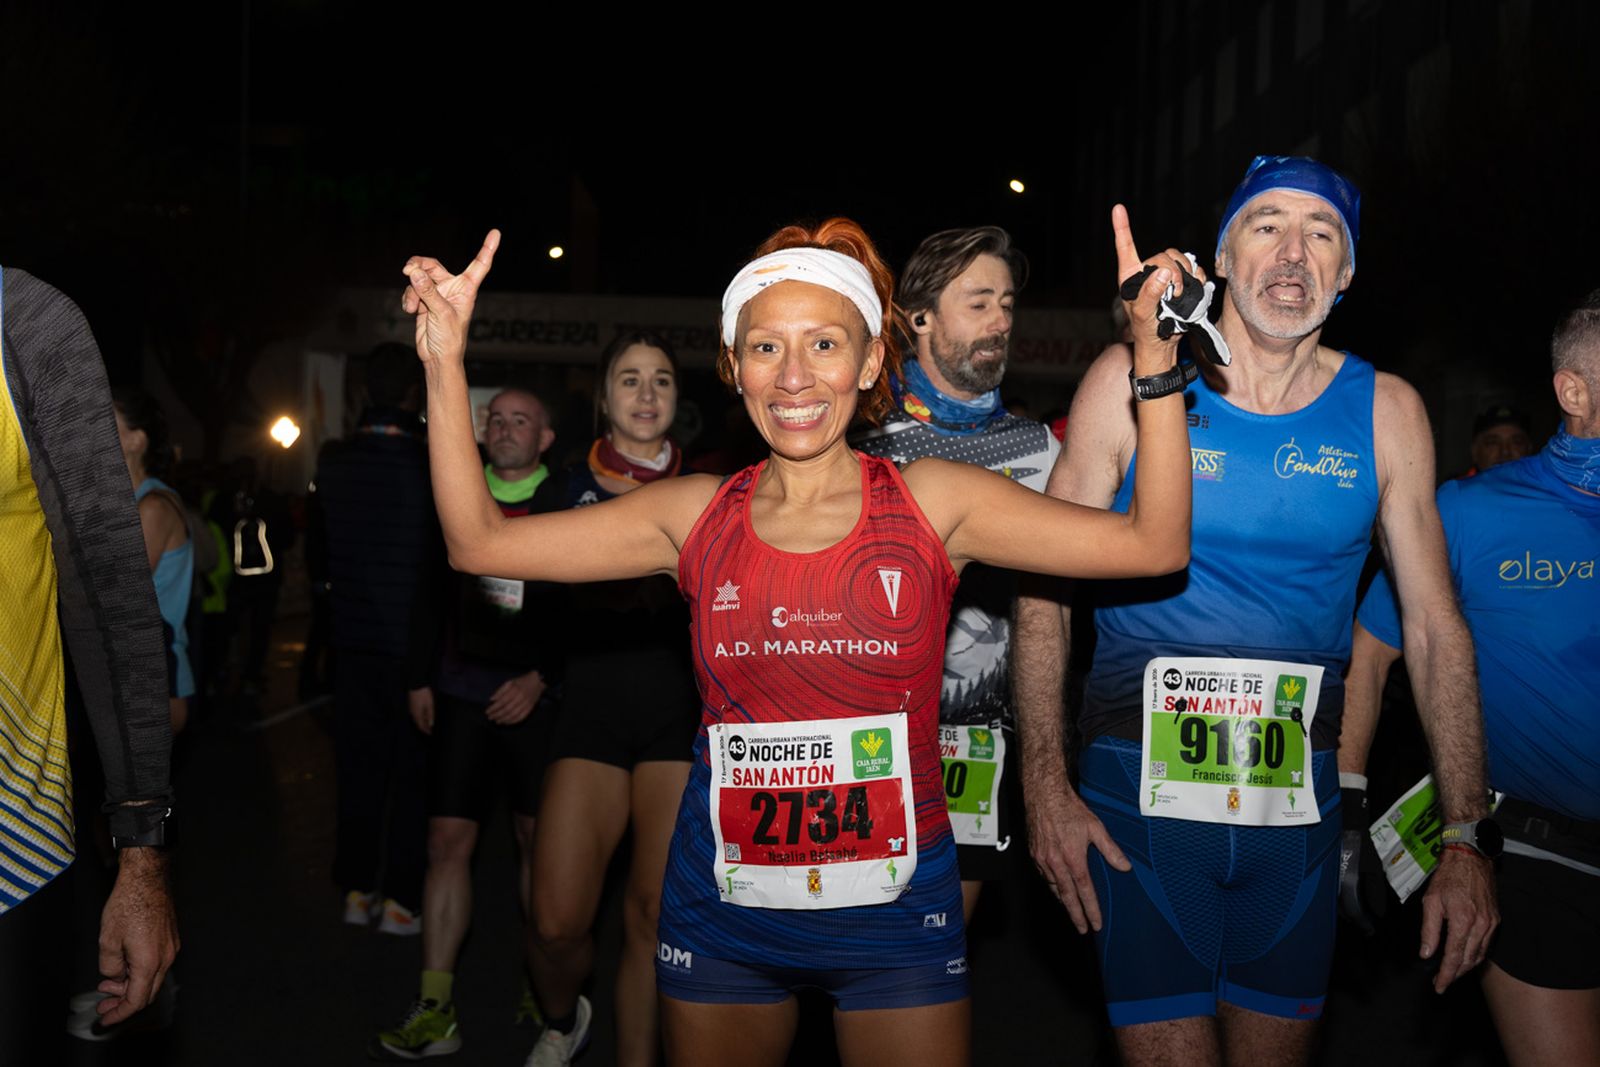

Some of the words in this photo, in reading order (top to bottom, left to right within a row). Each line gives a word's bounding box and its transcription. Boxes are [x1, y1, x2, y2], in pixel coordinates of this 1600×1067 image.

[470, 319, 598, 345] CARRERA
[1014, 338, 1072, 364] SAN
[1283, 452, 1358, 479] FondOlivo
[1499, 550, 1594, 588] olaya
[712, 601, 741, 612] luanvi
[789, 608, 843, 627] alquiber
[714, 641, 756, 658] A.D.
[764, 639, 898, 656] MARATHON
[1164, 673, 1181, 685] 43
[1185, 677, 1238, 693] NOCHE
[1242, 680, 1263, 694] DE
[1164, 695, 1200, 713] SN
[1202, 695, 1263, 716] ANTÓN
[791, 735, 832, 743] INTERNACIONAL
[945, 729, 959, 741] DE
[1179, 716, 1285, 769] 9160
[729, 740, 746, 754] 43
[749, 743, 806, 762] NOCHE
[811, 742, 833, 760] DE
[732, 767, 765, 786] SAN
[768, 760, 834, 786] ANTÓN
[1192, 768, 1245, 783] Francisco
[1247, 771, 1273, 785] Jesús
[750, 786, 874, 845] 2734
